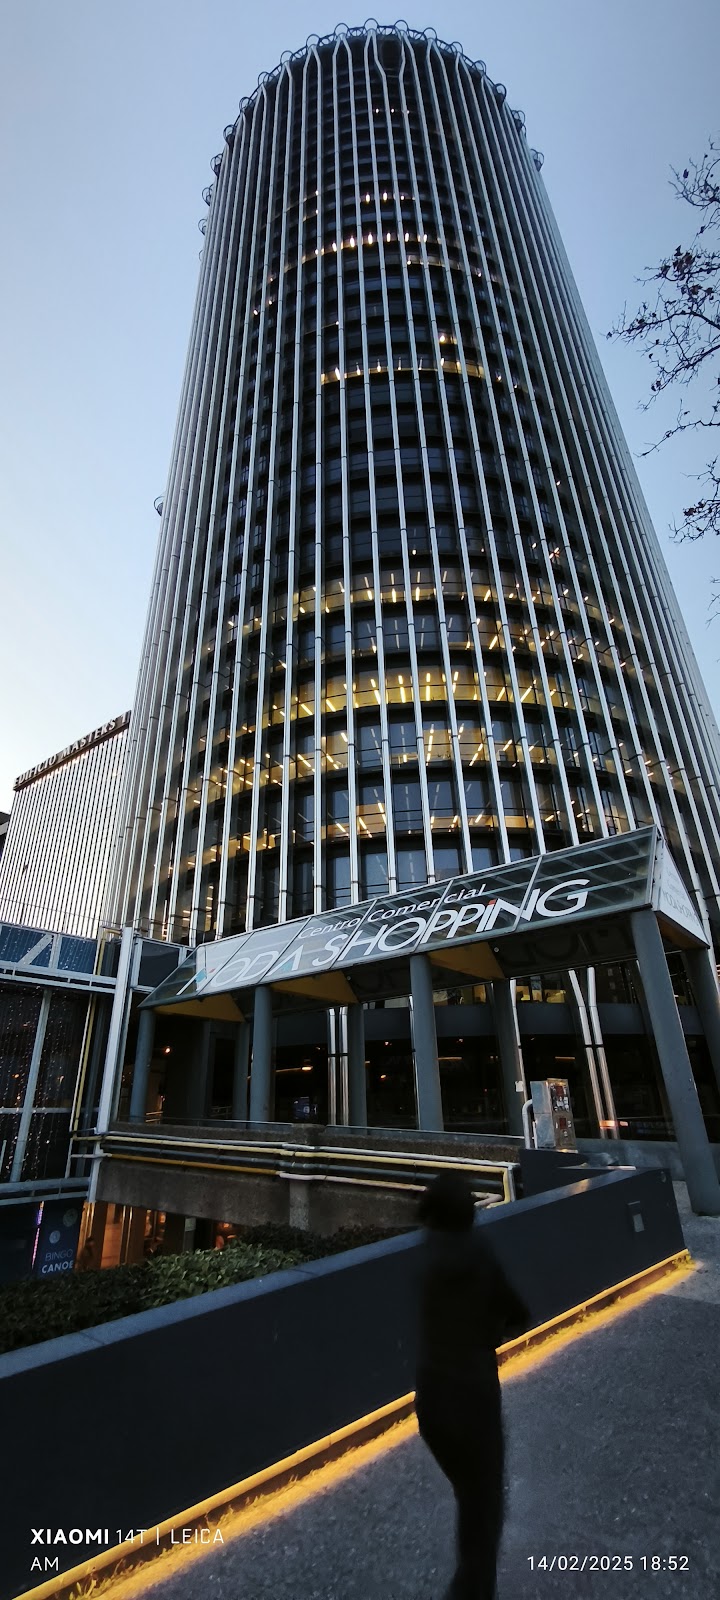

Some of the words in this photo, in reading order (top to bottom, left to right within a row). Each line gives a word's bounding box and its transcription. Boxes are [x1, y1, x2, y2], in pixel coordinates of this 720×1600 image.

[14, 753, 57, 787] EDIFICIO
[60, 719, 116, 758] MASTERS
[297, 917, 362, 939] Centro
[367, 884, 487, 923] Comercial
[176, 944, 304, 996] MODA
[41, 1260, 74, 1274] CANOE
[45, 1249, 73, 1261] BINGO
